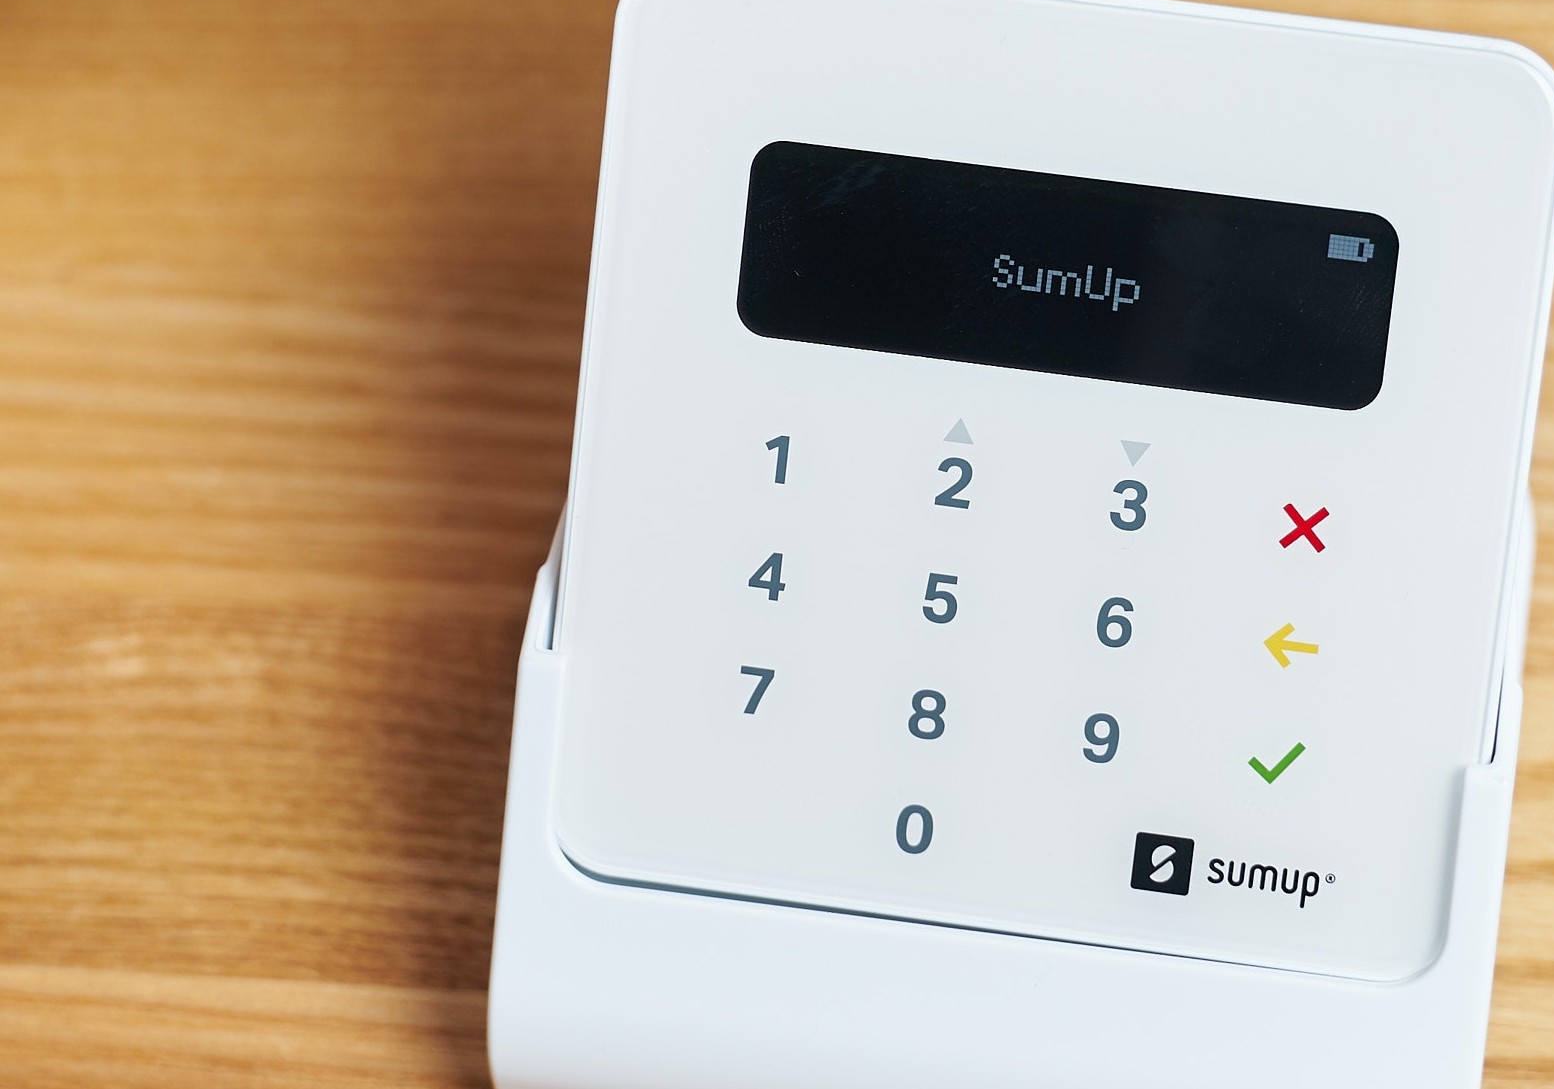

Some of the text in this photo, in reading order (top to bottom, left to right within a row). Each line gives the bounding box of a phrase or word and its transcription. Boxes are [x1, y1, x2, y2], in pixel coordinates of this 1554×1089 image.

[992, 254, 1141, 311] SumUp
[765, 435, 1149, 531] 1 2 3
[747, 552, 1134, 648] 4 5 6
[739, 665, 1121, 764] 7 8 9
[895, 804, 934, 854] 0
